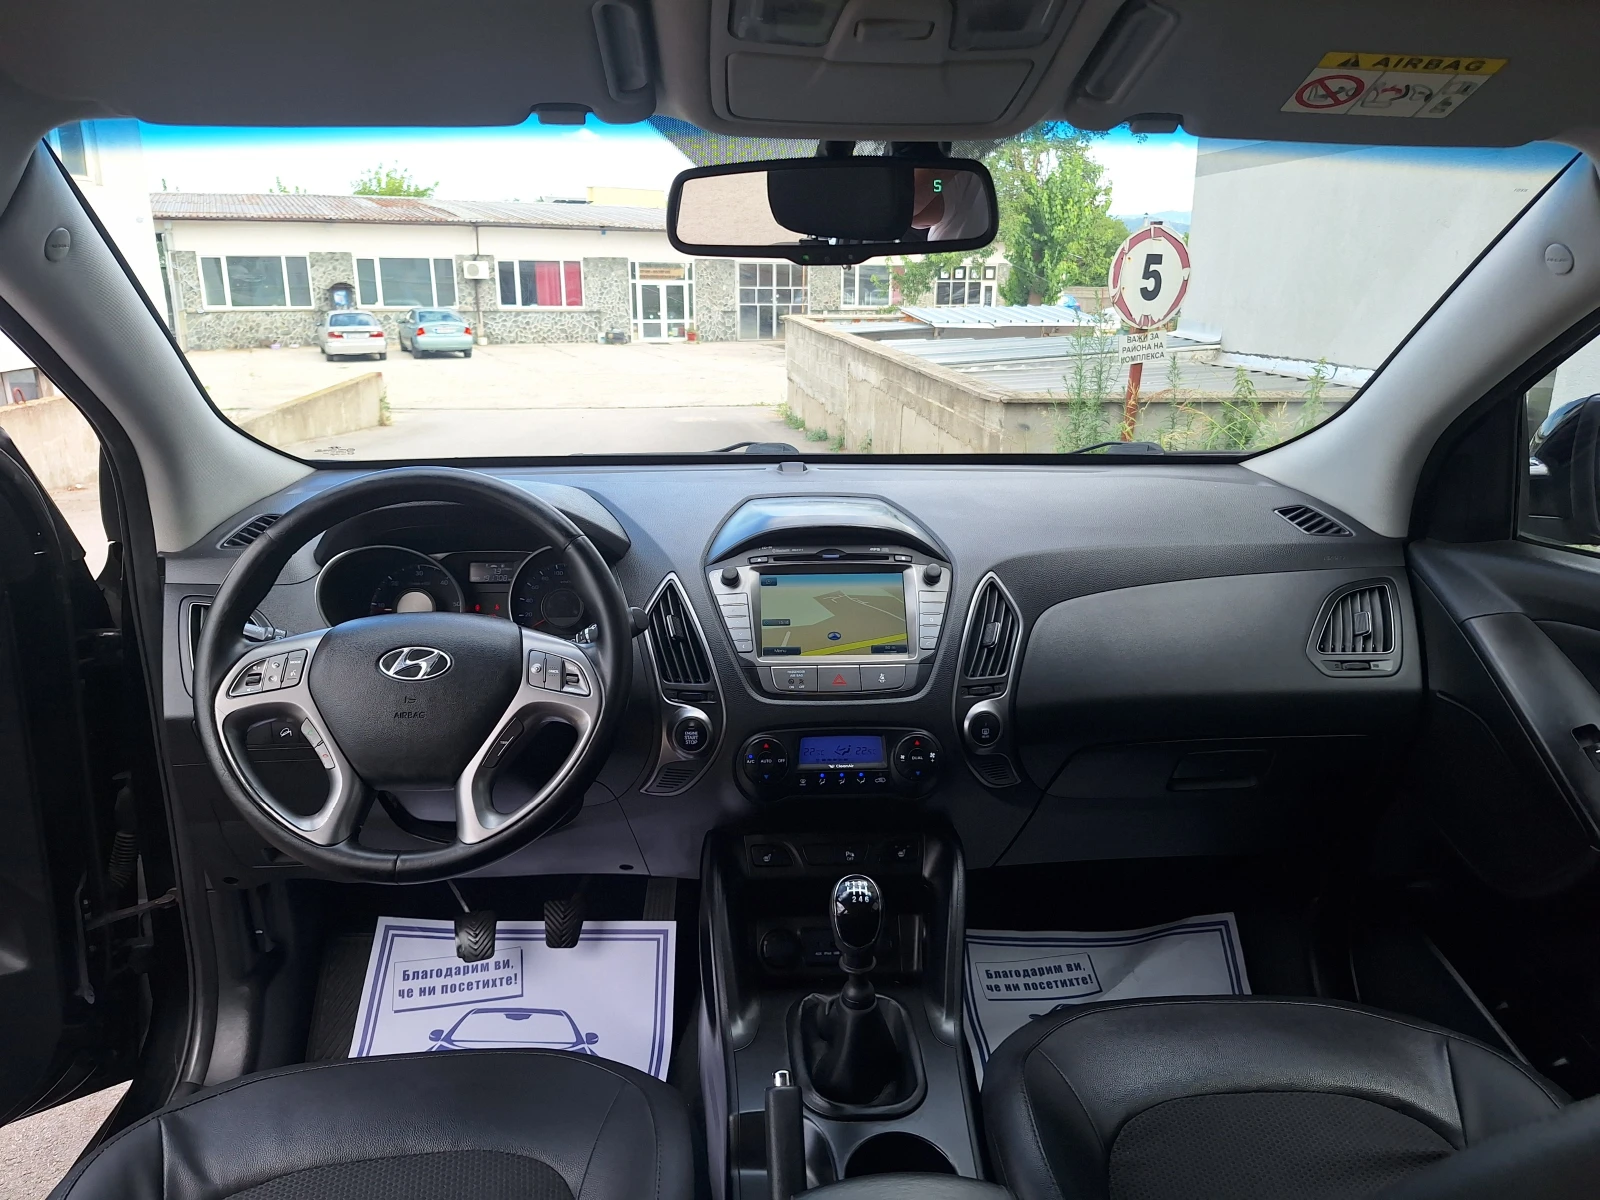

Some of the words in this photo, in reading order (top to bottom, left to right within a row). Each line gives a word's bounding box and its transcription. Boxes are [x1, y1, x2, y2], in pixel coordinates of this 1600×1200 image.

[1371, 56, 1486, 72] AIRBAG
[933, 180, 942, 192] S
[1140, 253, 1163, 301] 5
[1127, 334, 1148, 344] ВАЖИ
[1150, 332, 1159, 341] ЗА
[1122, 343, 1151, 354] РАЙОНА
[1153, 341, 1164, 350] НА
[1120, 351, 1165, 364] КОМПЛЕКСА
[393, 711, 426, 719] AIRBAG
[402, 961, 490, 981] Благодарим
[494, 958, 514, 970] ви,
[985, 963, 1063, 980] Благодарим
[1066, 961, 1086, 972] ви,
[398, 987, 414, 999] че
[418, 985, 436, 997] ни
[440, 972, 518, 995] посетихте!
[986, 984, 1001, 993] че
[1004, 983, 1021, 992] ни
[1024, 973, 1094, 991] посетихте!
